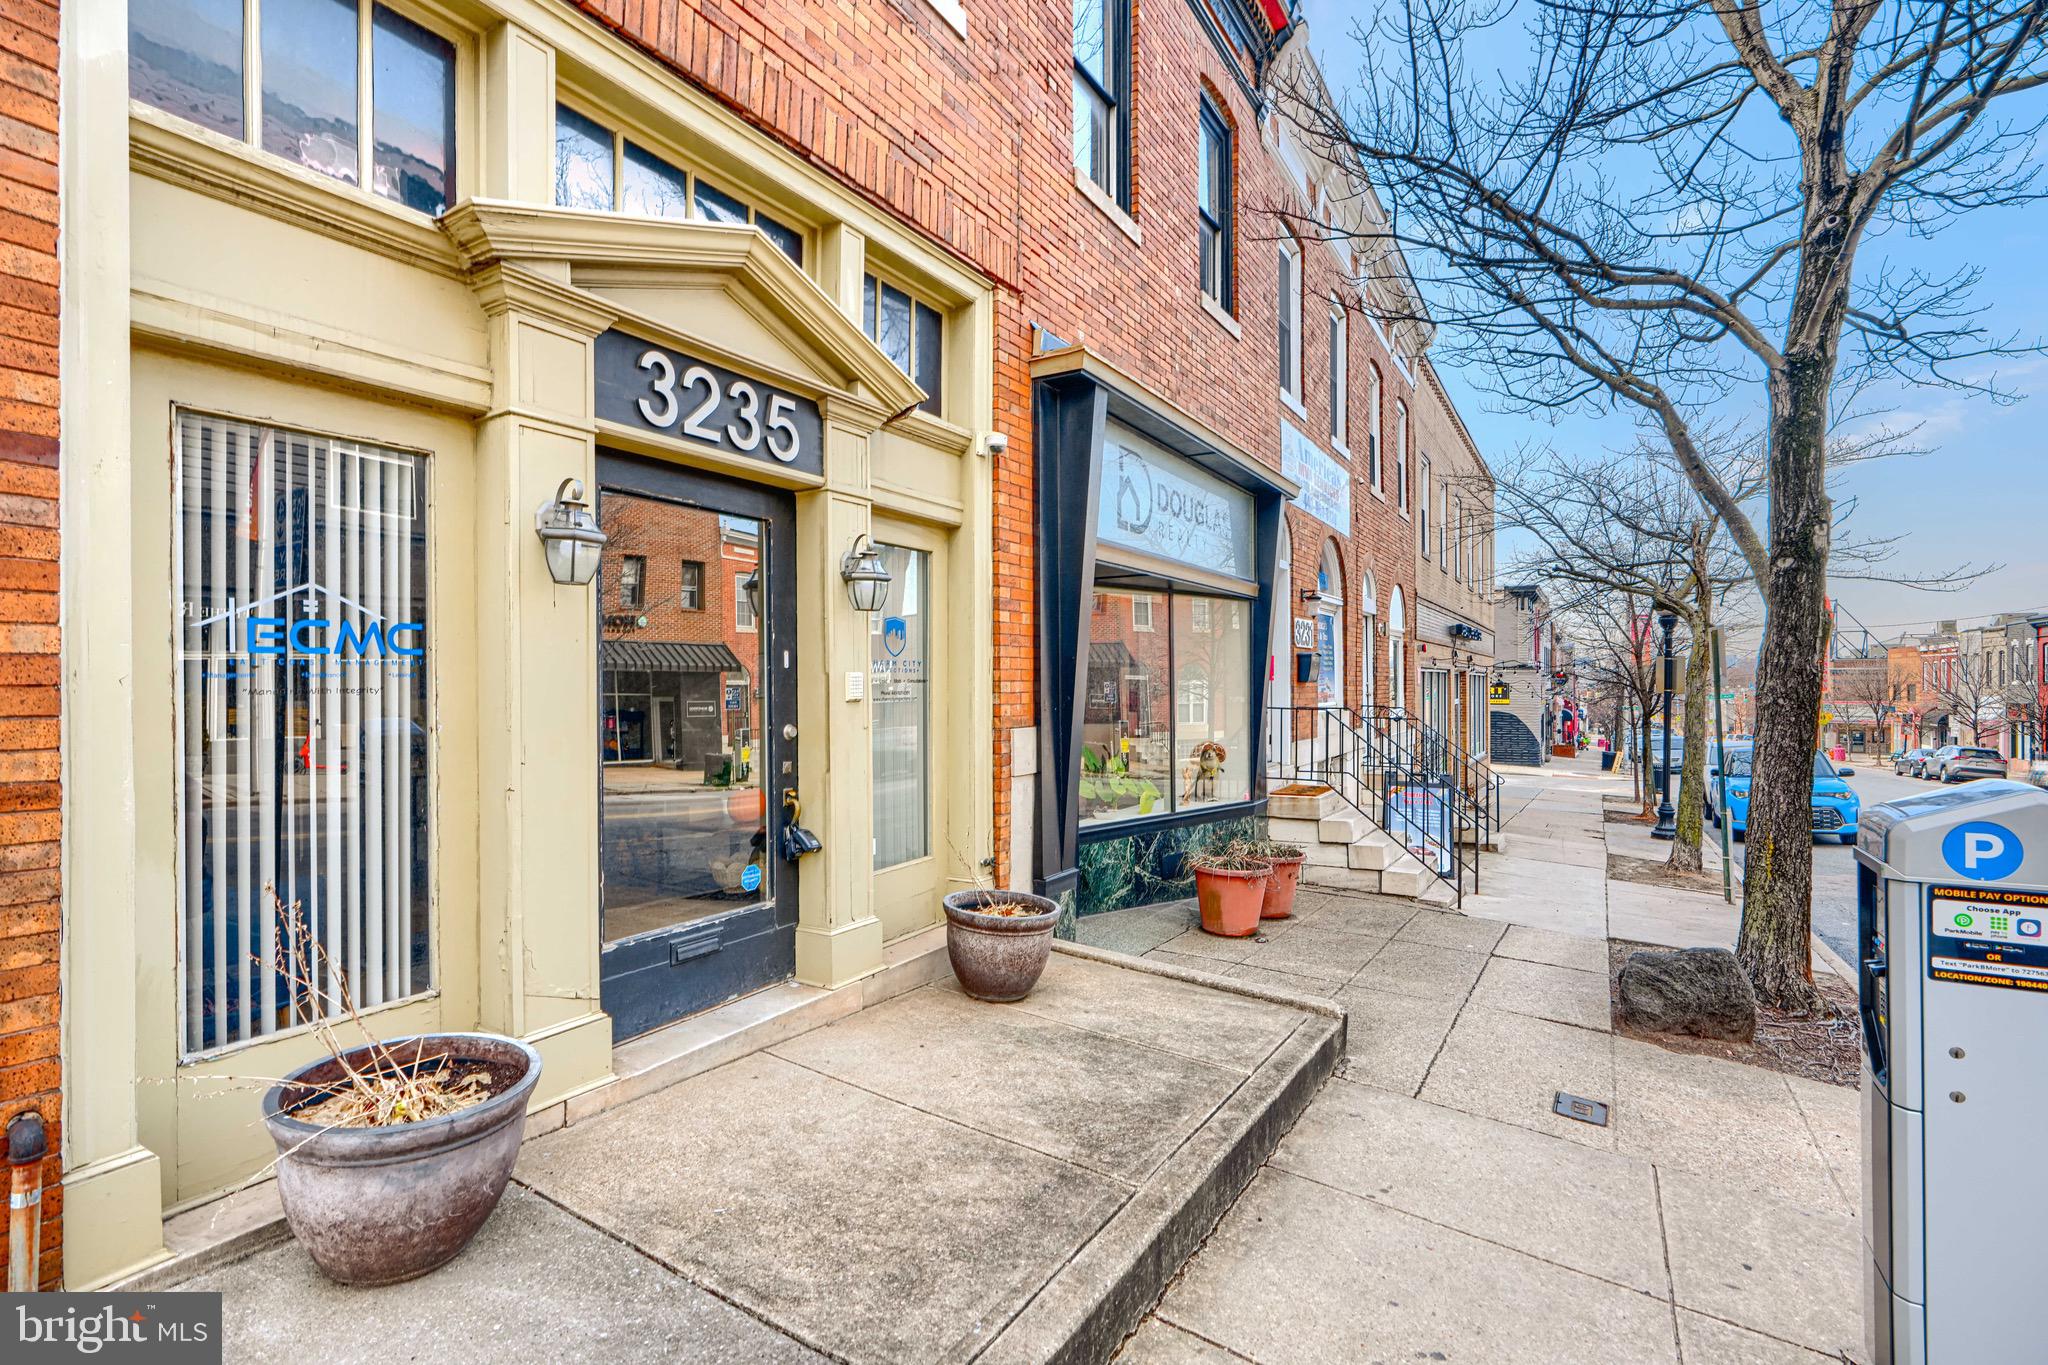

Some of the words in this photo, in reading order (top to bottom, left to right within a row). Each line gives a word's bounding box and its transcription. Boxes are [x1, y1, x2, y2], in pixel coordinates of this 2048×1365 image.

[637, 350, 800, 462] 3235
[1157, 483, 1231, 537] DOUGLAS
[247, 617, 424, 656] ECMC
[1295, 620, 1313, 647] 3231
[335, 658, 424, 667] MANAGEMENT
[903, 660, 922, 668] CITY
[1965, 832, 2005, 869] P
[1934, 888, 1977, 899] MOBILE
[1979, 891, 2001, 901] PAY
[1966, 905, 2000, 914] Choose
[2002, 908, 2021, 917] App
[1944, 927, 1983, 937] ParkMobile
[1986, 953, 2002, 961] OR
[1934, 970, 2014, 986] LOCATION/ZONE:
